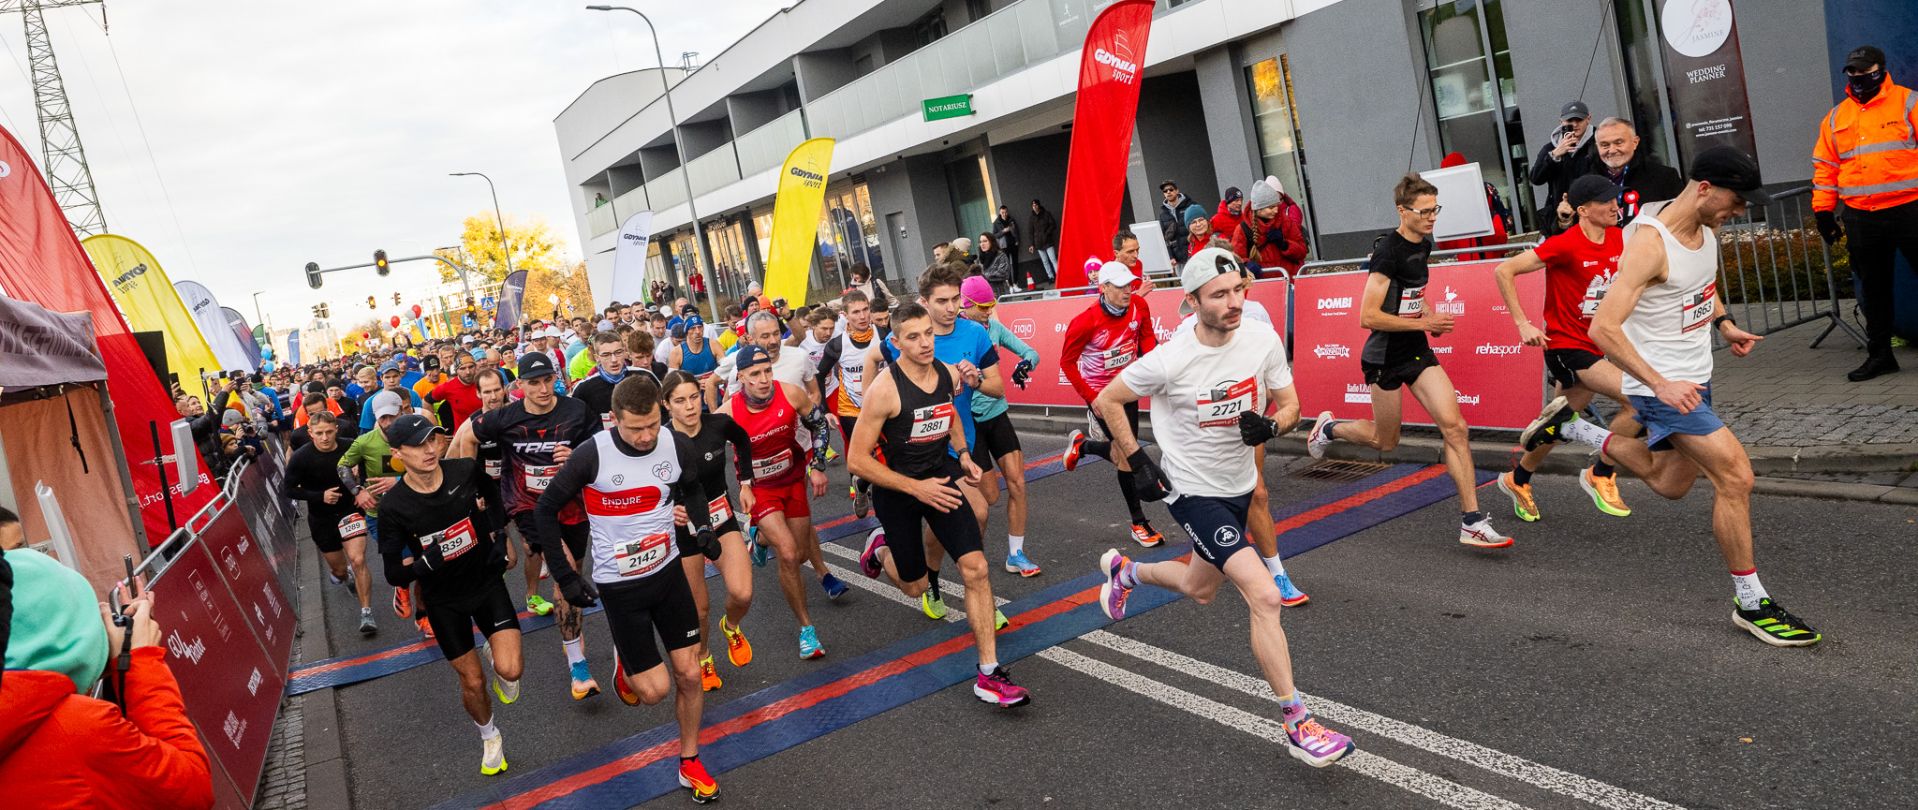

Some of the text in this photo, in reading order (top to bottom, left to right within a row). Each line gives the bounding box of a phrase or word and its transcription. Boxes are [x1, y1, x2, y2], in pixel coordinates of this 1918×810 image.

[1094, 48, 1137, 74] GDYNIA
[1112, 69, 1135, 85] sport
[1686, 64, 1726, 78] WEDDING
[1690, 71, 1726, 84] PLANNER
[928, 101, 967, 113] NOTARIUSZ
[790, 167, 823, 182] GDYNIA
[1317, 297, 1352, 309] DOMBI
[1692, 302, 1713, 321] 1863
[1475, 342, 1522, 358] rehasport
[1110, 355, 1129, 366] 2105
[1211, 399, 1242, 416] 2721
[920, 419, 943, 433] 2881
[761, 464, 783, 475] 1256
[602, 495, 642, 506] ENDURE
[344, 521, 361, 532] 1289
[441, 537, 463, 553] 839
[629, 549, 657, 568] 2142
